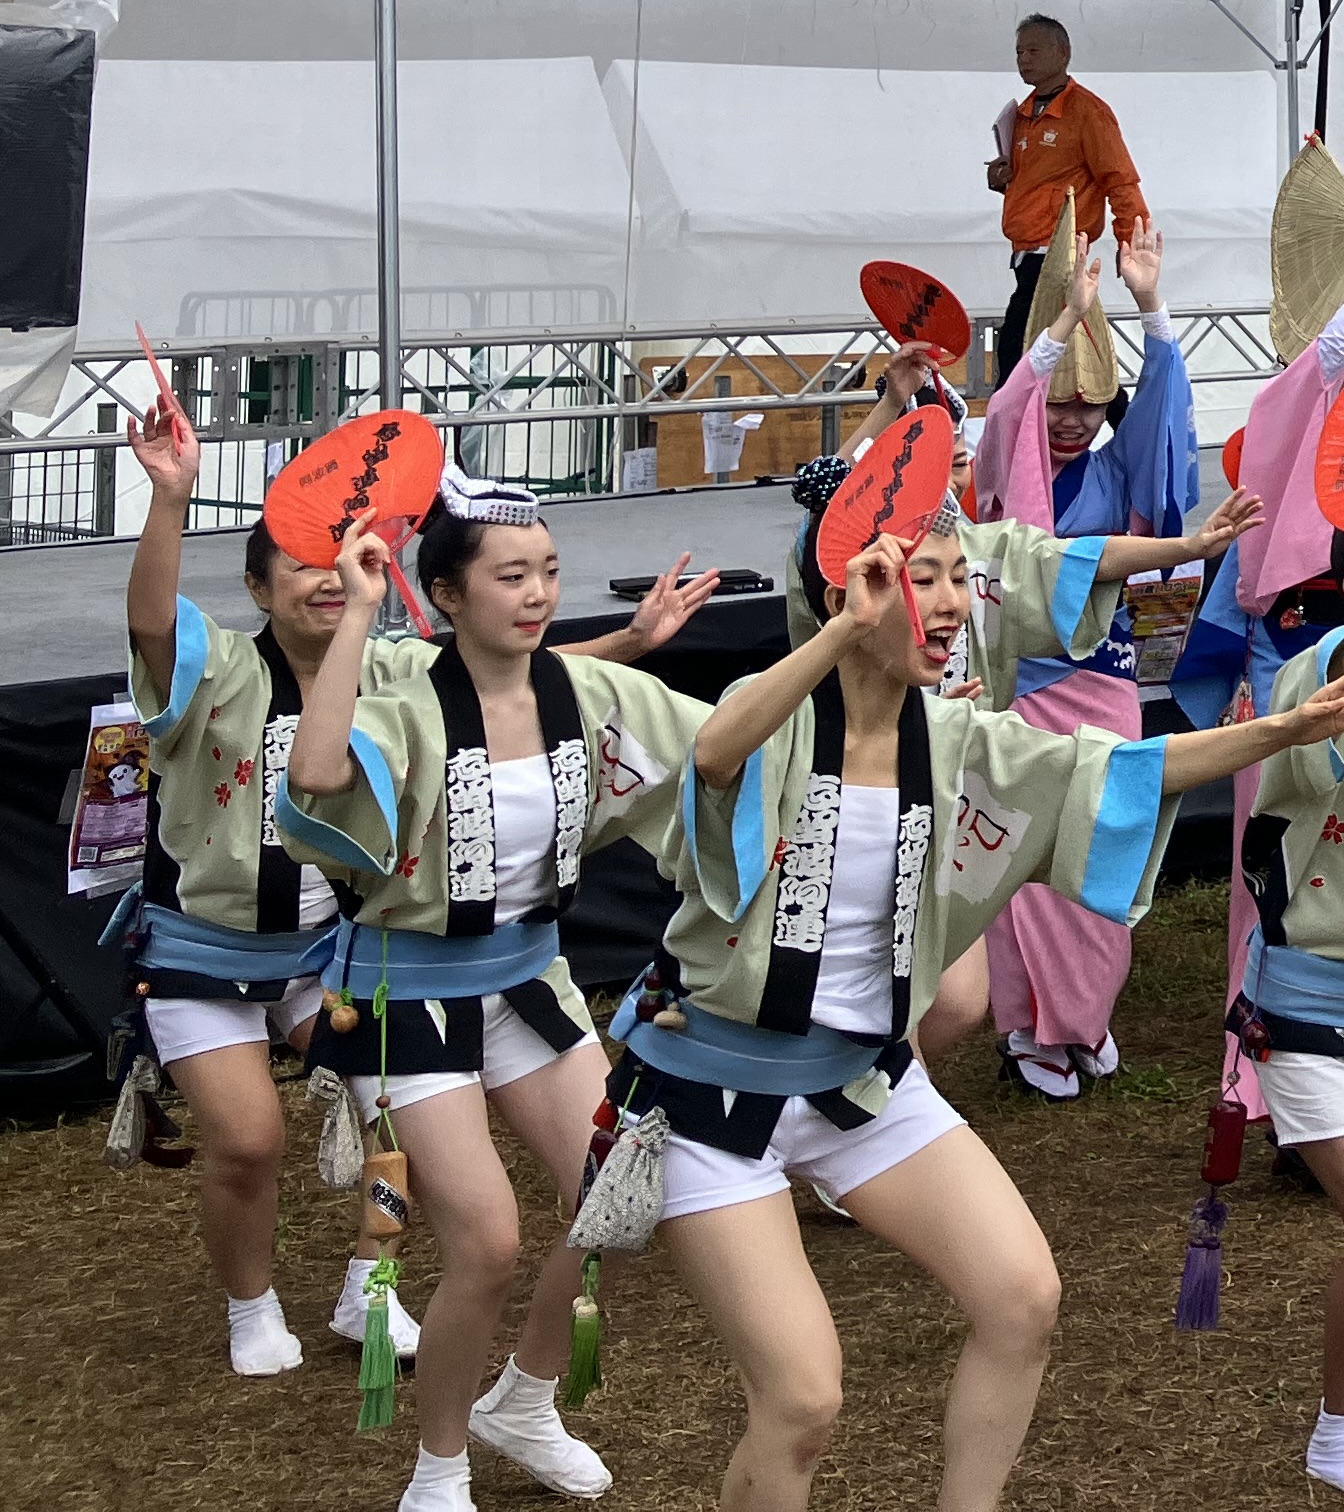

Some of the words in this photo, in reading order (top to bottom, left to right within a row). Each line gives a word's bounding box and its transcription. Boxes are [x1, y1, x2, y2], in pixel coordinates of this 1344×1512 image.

[773, 772, 841, 953] 志留波阿連
